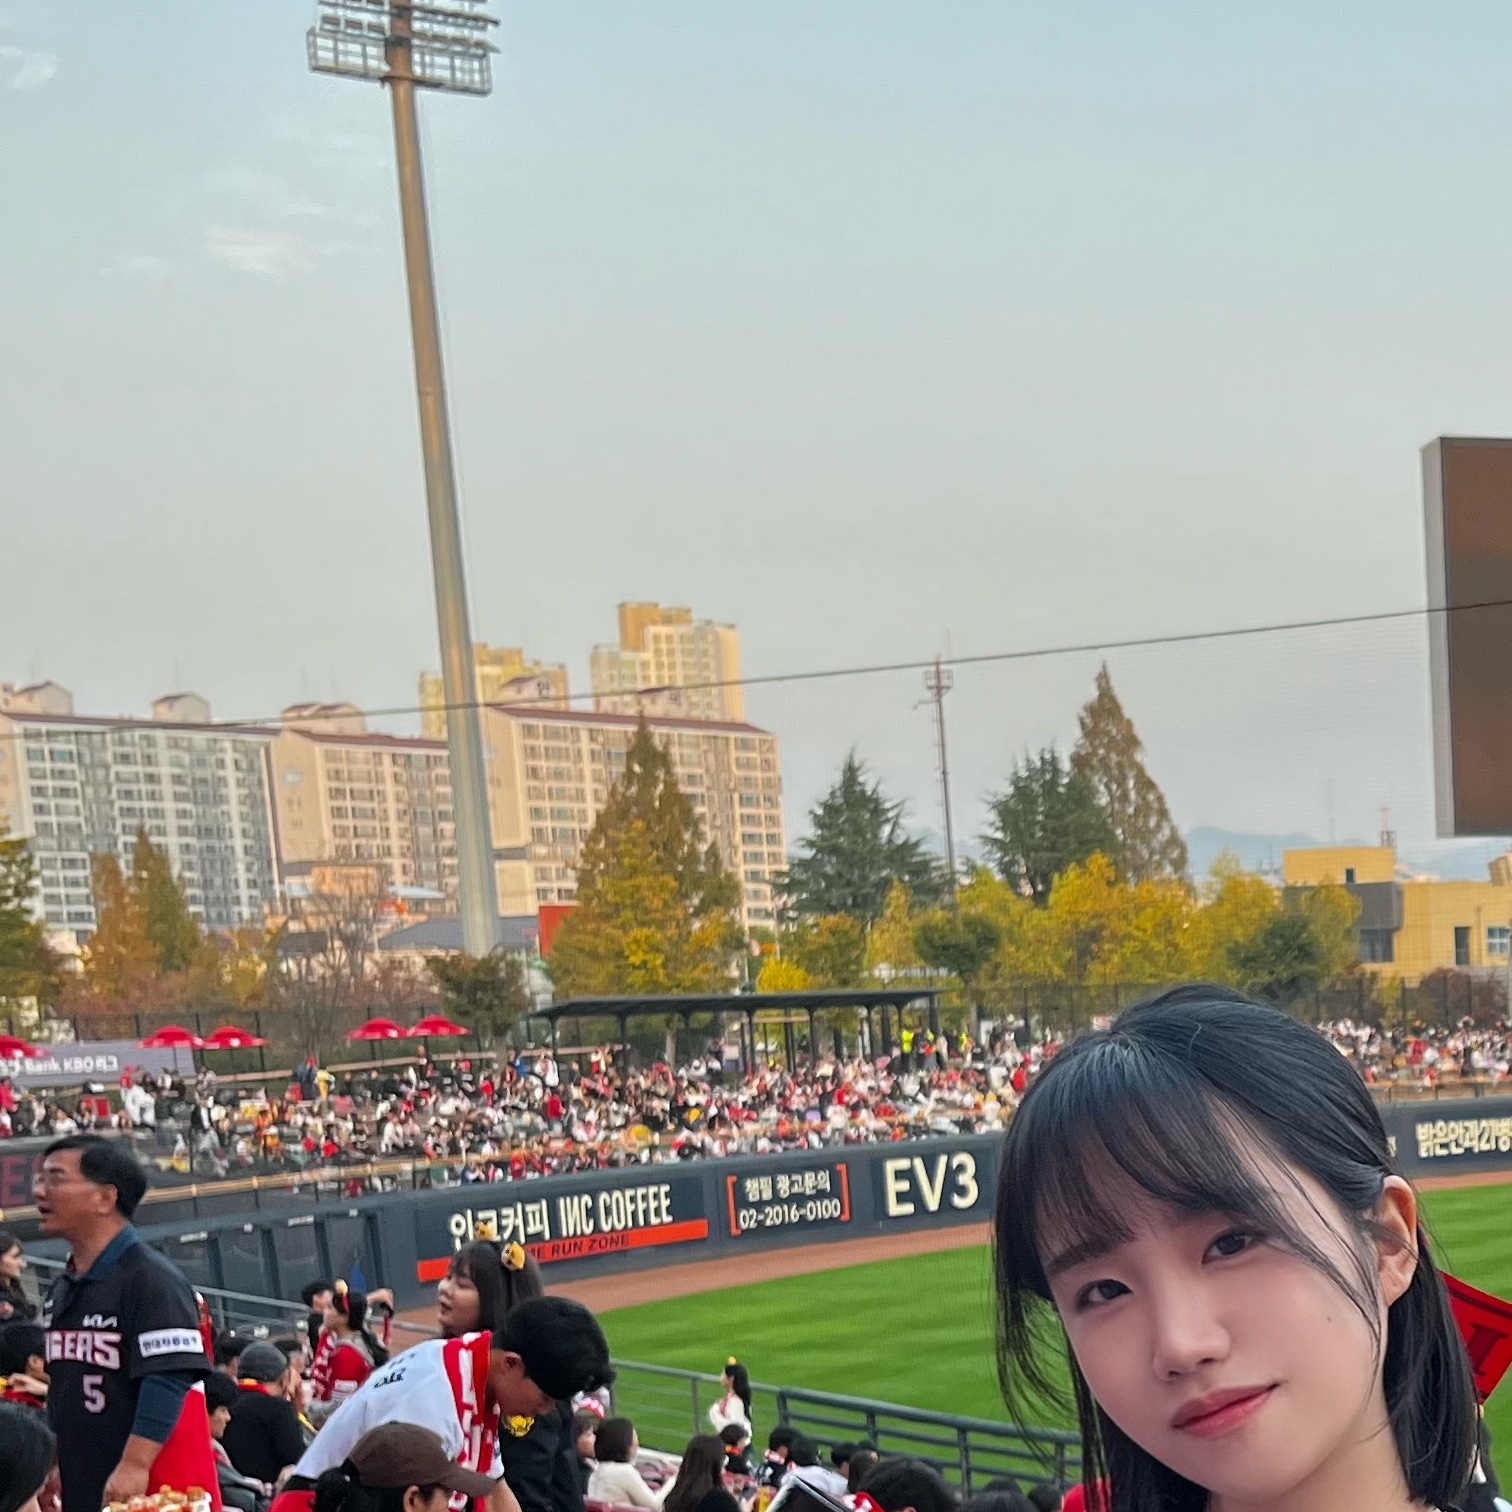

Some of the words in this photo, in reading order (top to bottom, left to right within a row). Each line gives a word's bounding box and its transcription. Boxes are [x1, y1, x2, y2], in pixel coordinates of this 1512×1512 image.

[25, 1056, 62, 1073] Bank
[63, 1056, 94, 1073] KBO
[884, 1150, 980, 1217] EV3
[598, 1184, 674, 1233] COFFEE
[739, 1197, 841, 1231] 02-2016-0100
[551, 1241, 585, 1260] RUN
[588, 1233, 630, 1253] ZONE
[82, 1373, 106, 1414] 5
